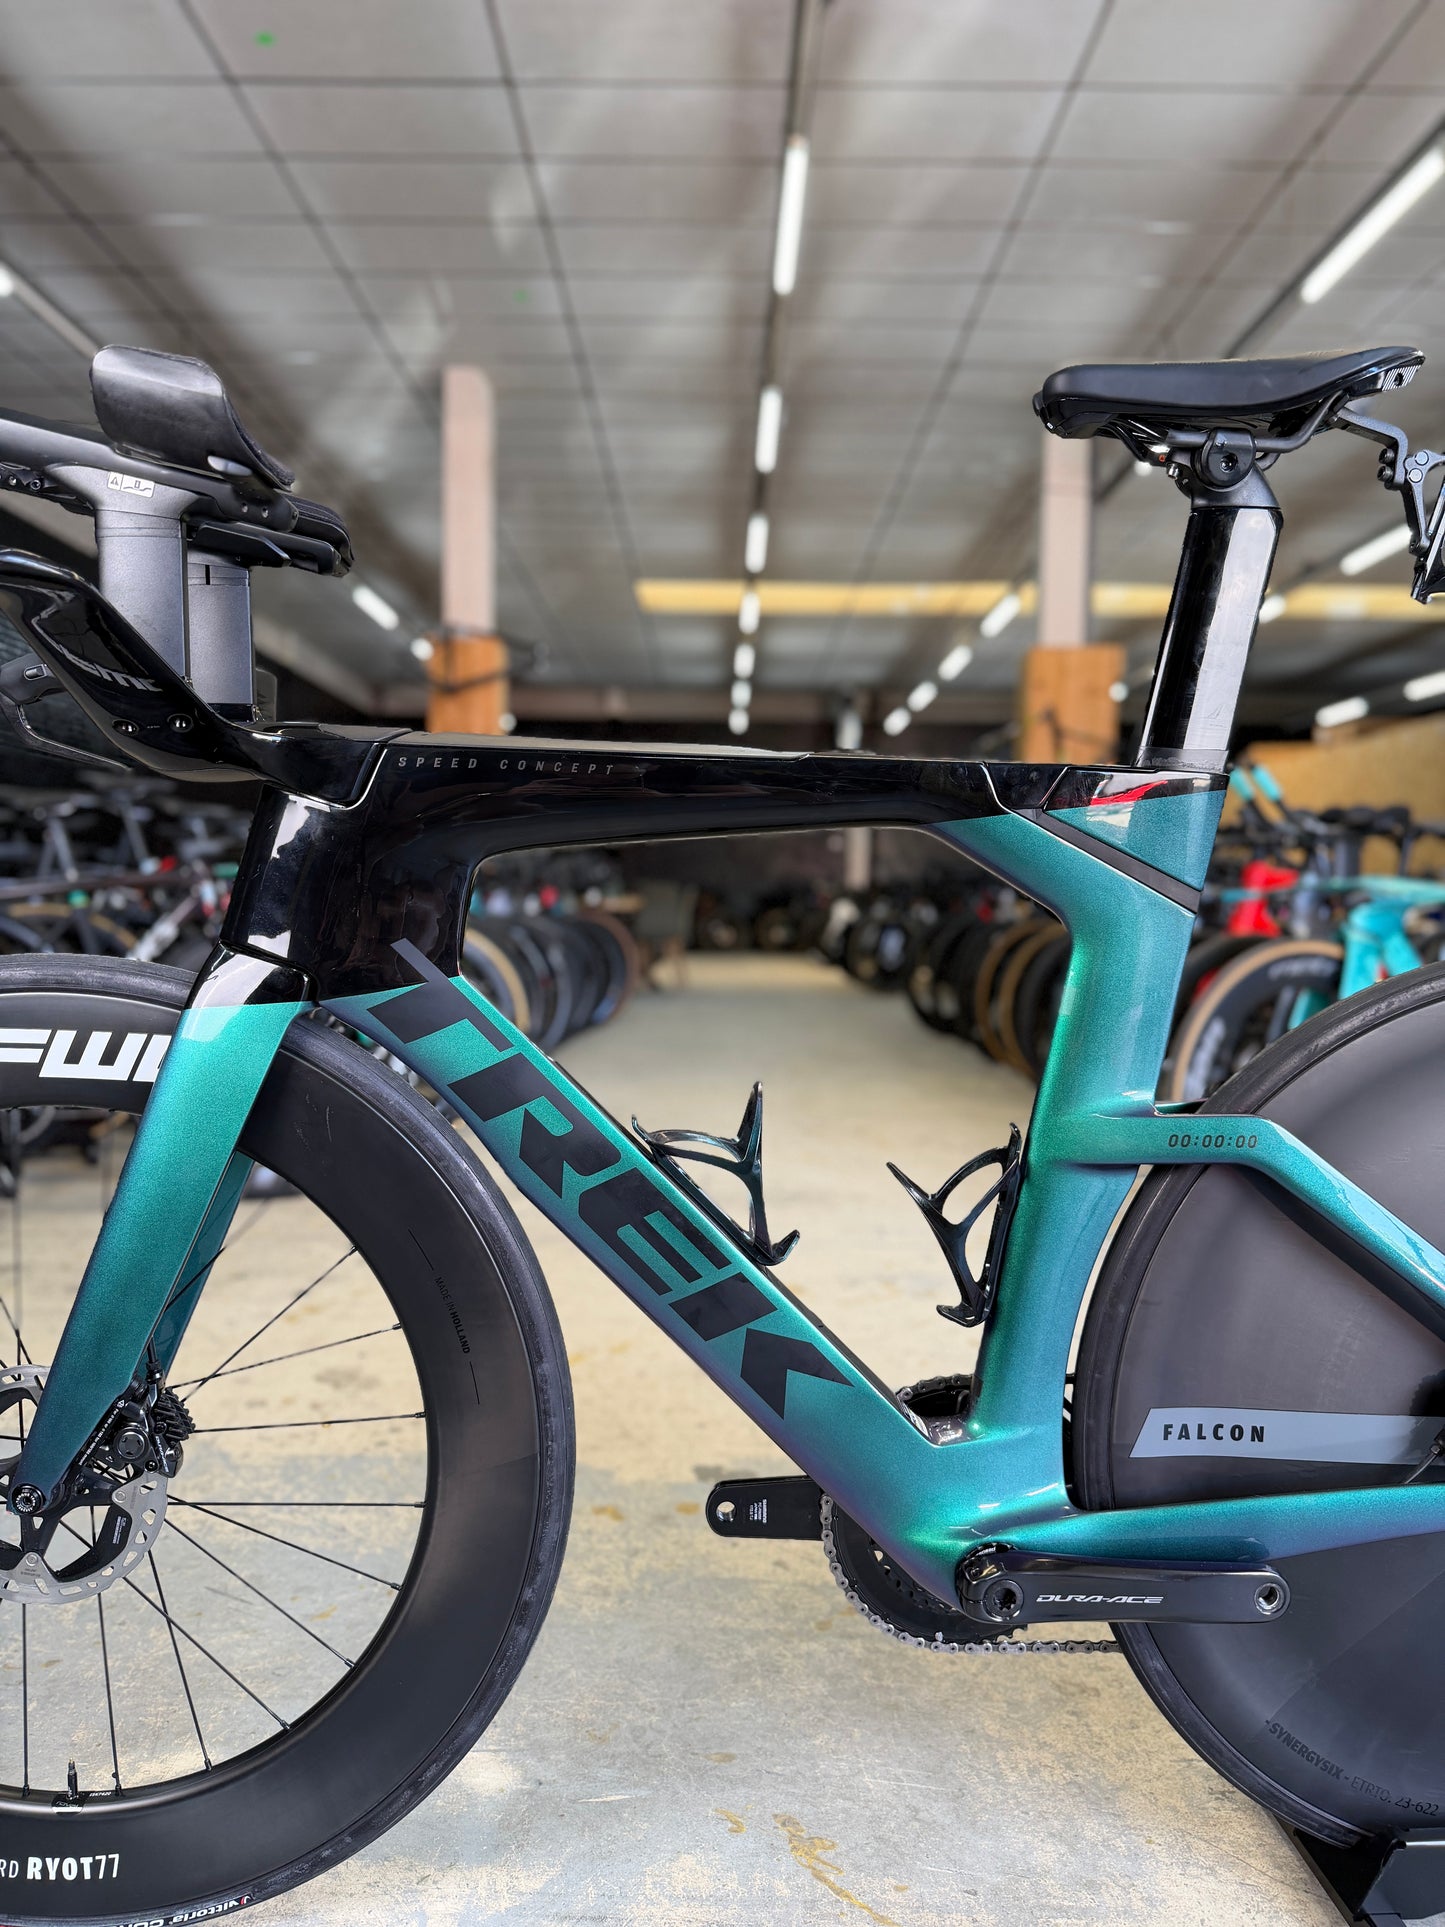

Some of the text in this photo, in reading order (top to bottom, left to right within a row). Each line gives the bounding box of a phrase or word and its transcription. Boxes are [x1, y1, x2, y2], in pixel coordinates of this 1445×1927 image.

[398, 757, 613, 775] SPEED CONCEPT
[1168, 1134, 1258, 1149] 00:00:00
[366, 938, 854, 1420] TREK
[434, 1277, 452, 1301] MADE
[450, 1311, 471, 1354] HOLLAND
[1162, 1423, 1265, 1443] FALCON
[1036, 1594, 1164, 1604] DURA-ACE
[26, 1853, 120, 1881] RYOT77
